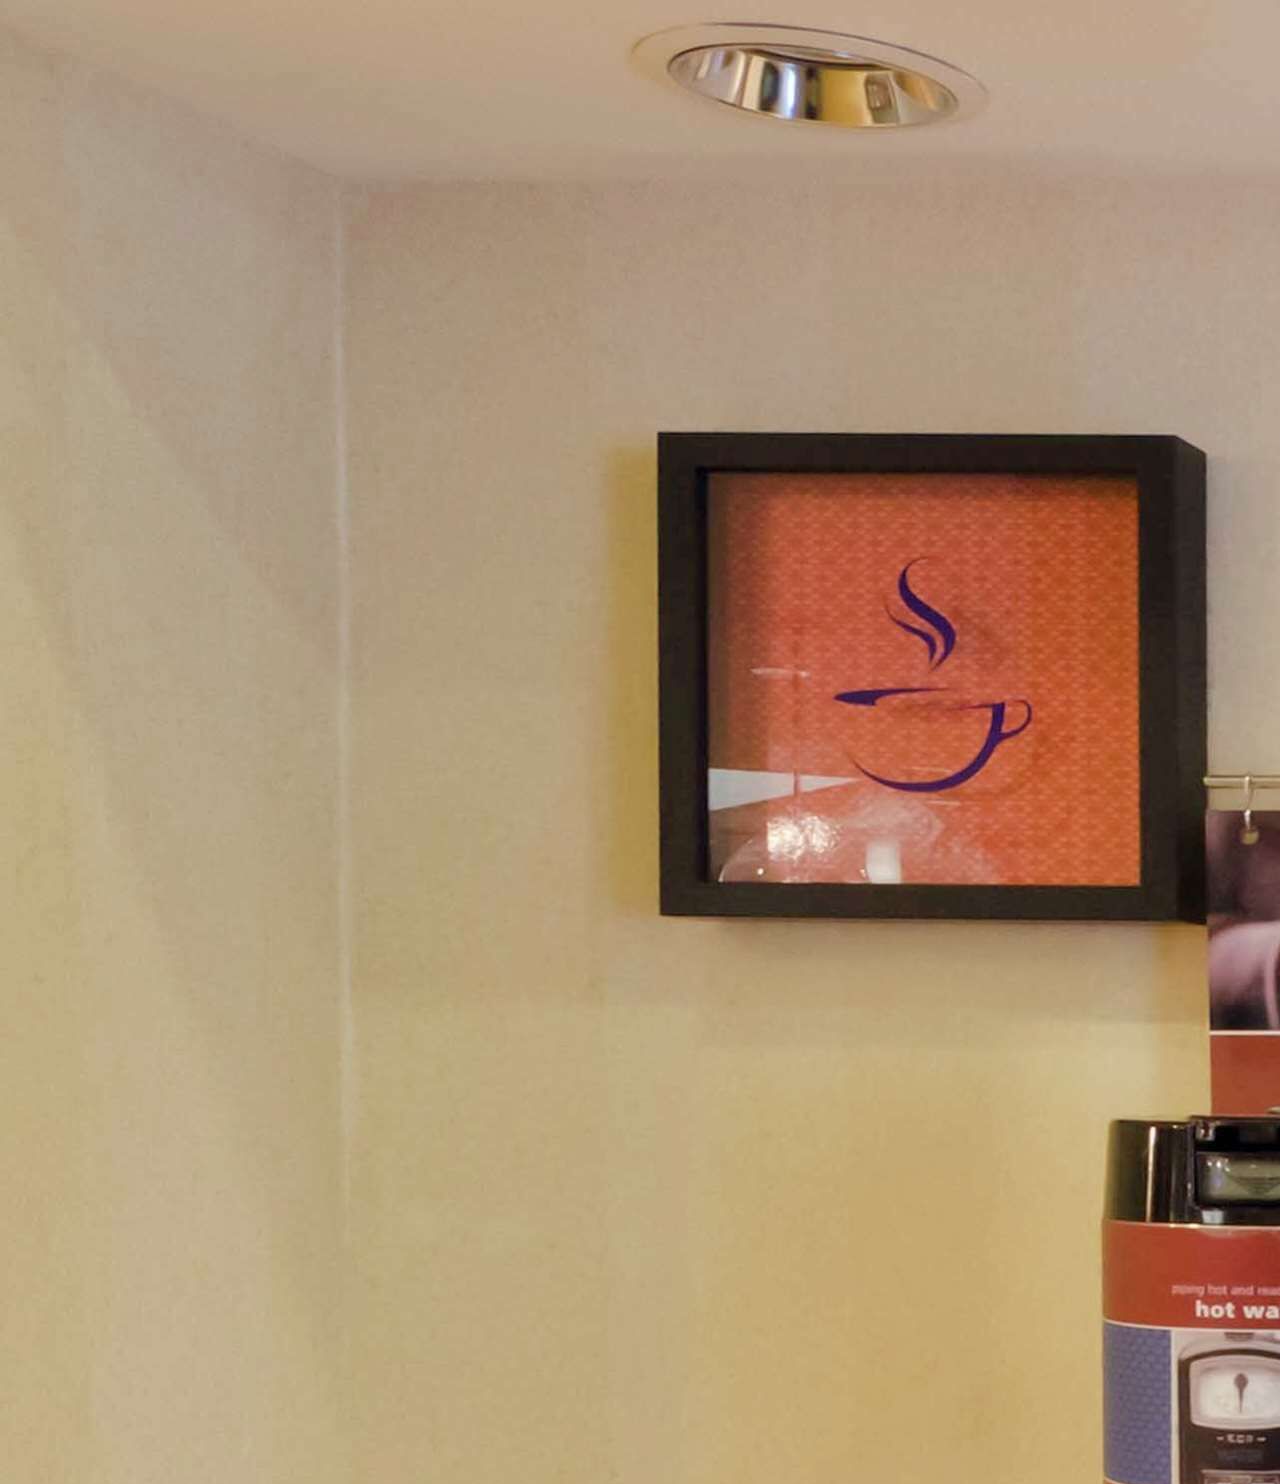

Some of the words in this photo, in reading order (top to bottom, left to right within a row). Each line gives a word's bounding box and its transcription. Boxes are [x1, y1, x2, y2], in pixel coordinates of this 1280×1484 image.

[1207, 1284, 1227, 1295] hot
[1230, 1285, 1254, 1295] and
[1195, 1299, 1235, 1318] hot
